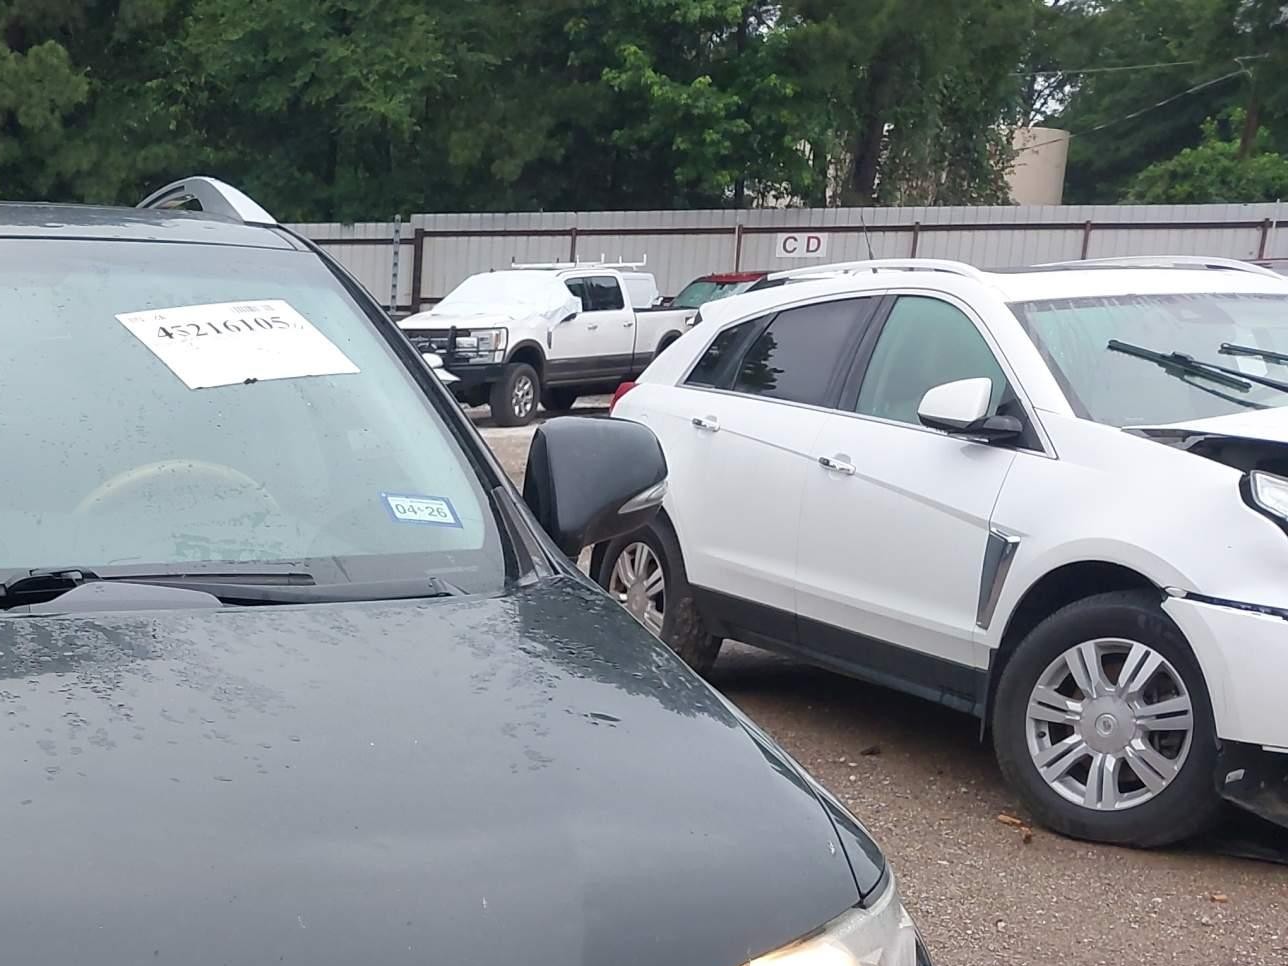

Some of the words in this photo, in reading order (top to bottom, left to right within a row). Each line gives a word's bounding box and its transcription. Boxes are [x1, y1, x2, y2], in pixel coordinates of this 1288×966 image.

[782, 236, 798, 254] C
[806, 236, 821, 253] D
[157, 316, 290, 339] 45216105
